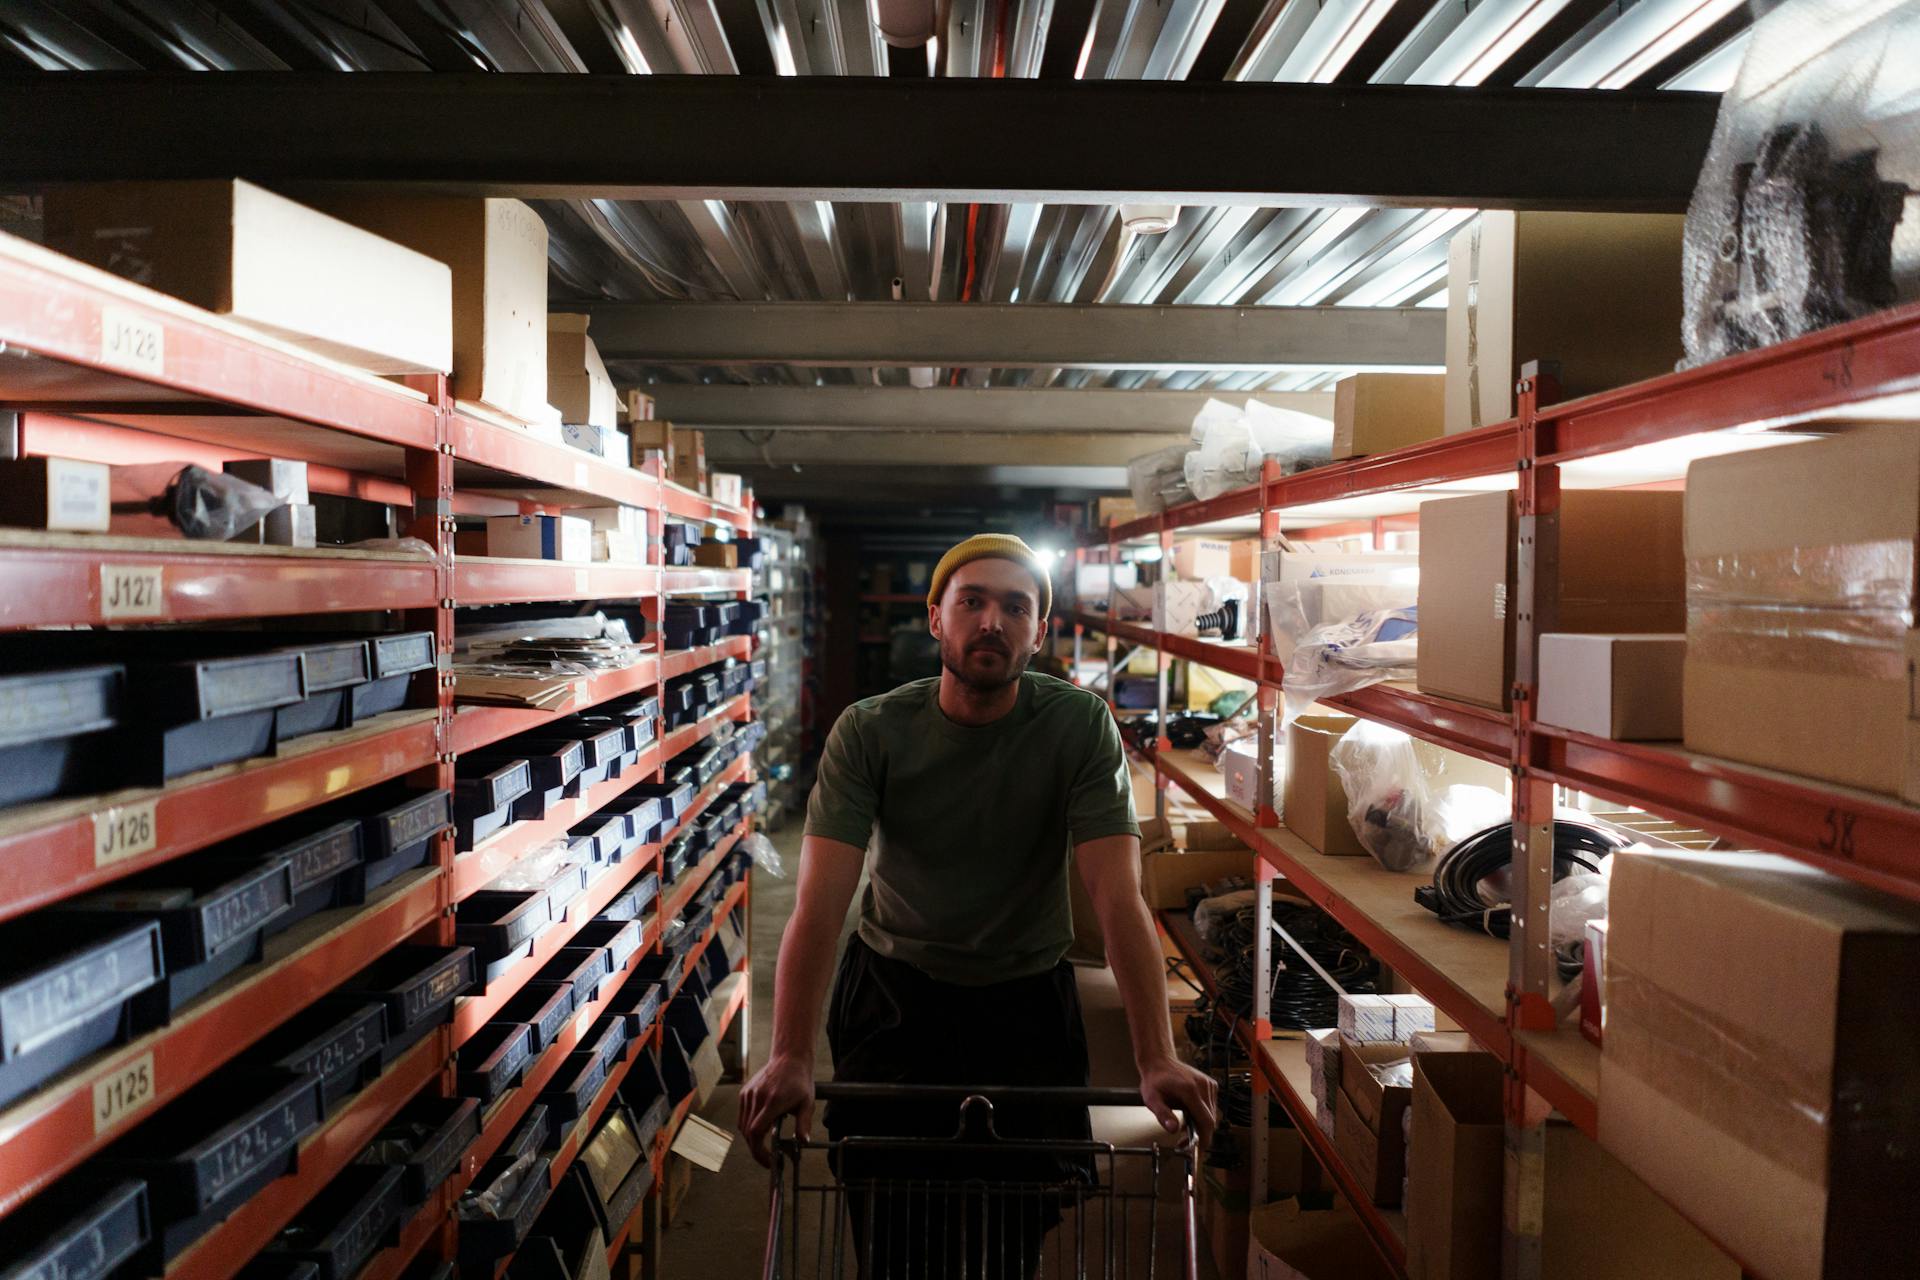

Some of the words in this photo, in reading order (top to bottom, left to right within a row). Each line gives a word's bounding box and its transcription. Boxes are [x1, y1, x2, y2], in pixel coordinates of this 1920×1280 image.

[110, 323, 157, 361] J128
[110, 576, 154, 607] J127
[103, 812, 149, 854] J126
[101, 1064, 148, 1119] J125
